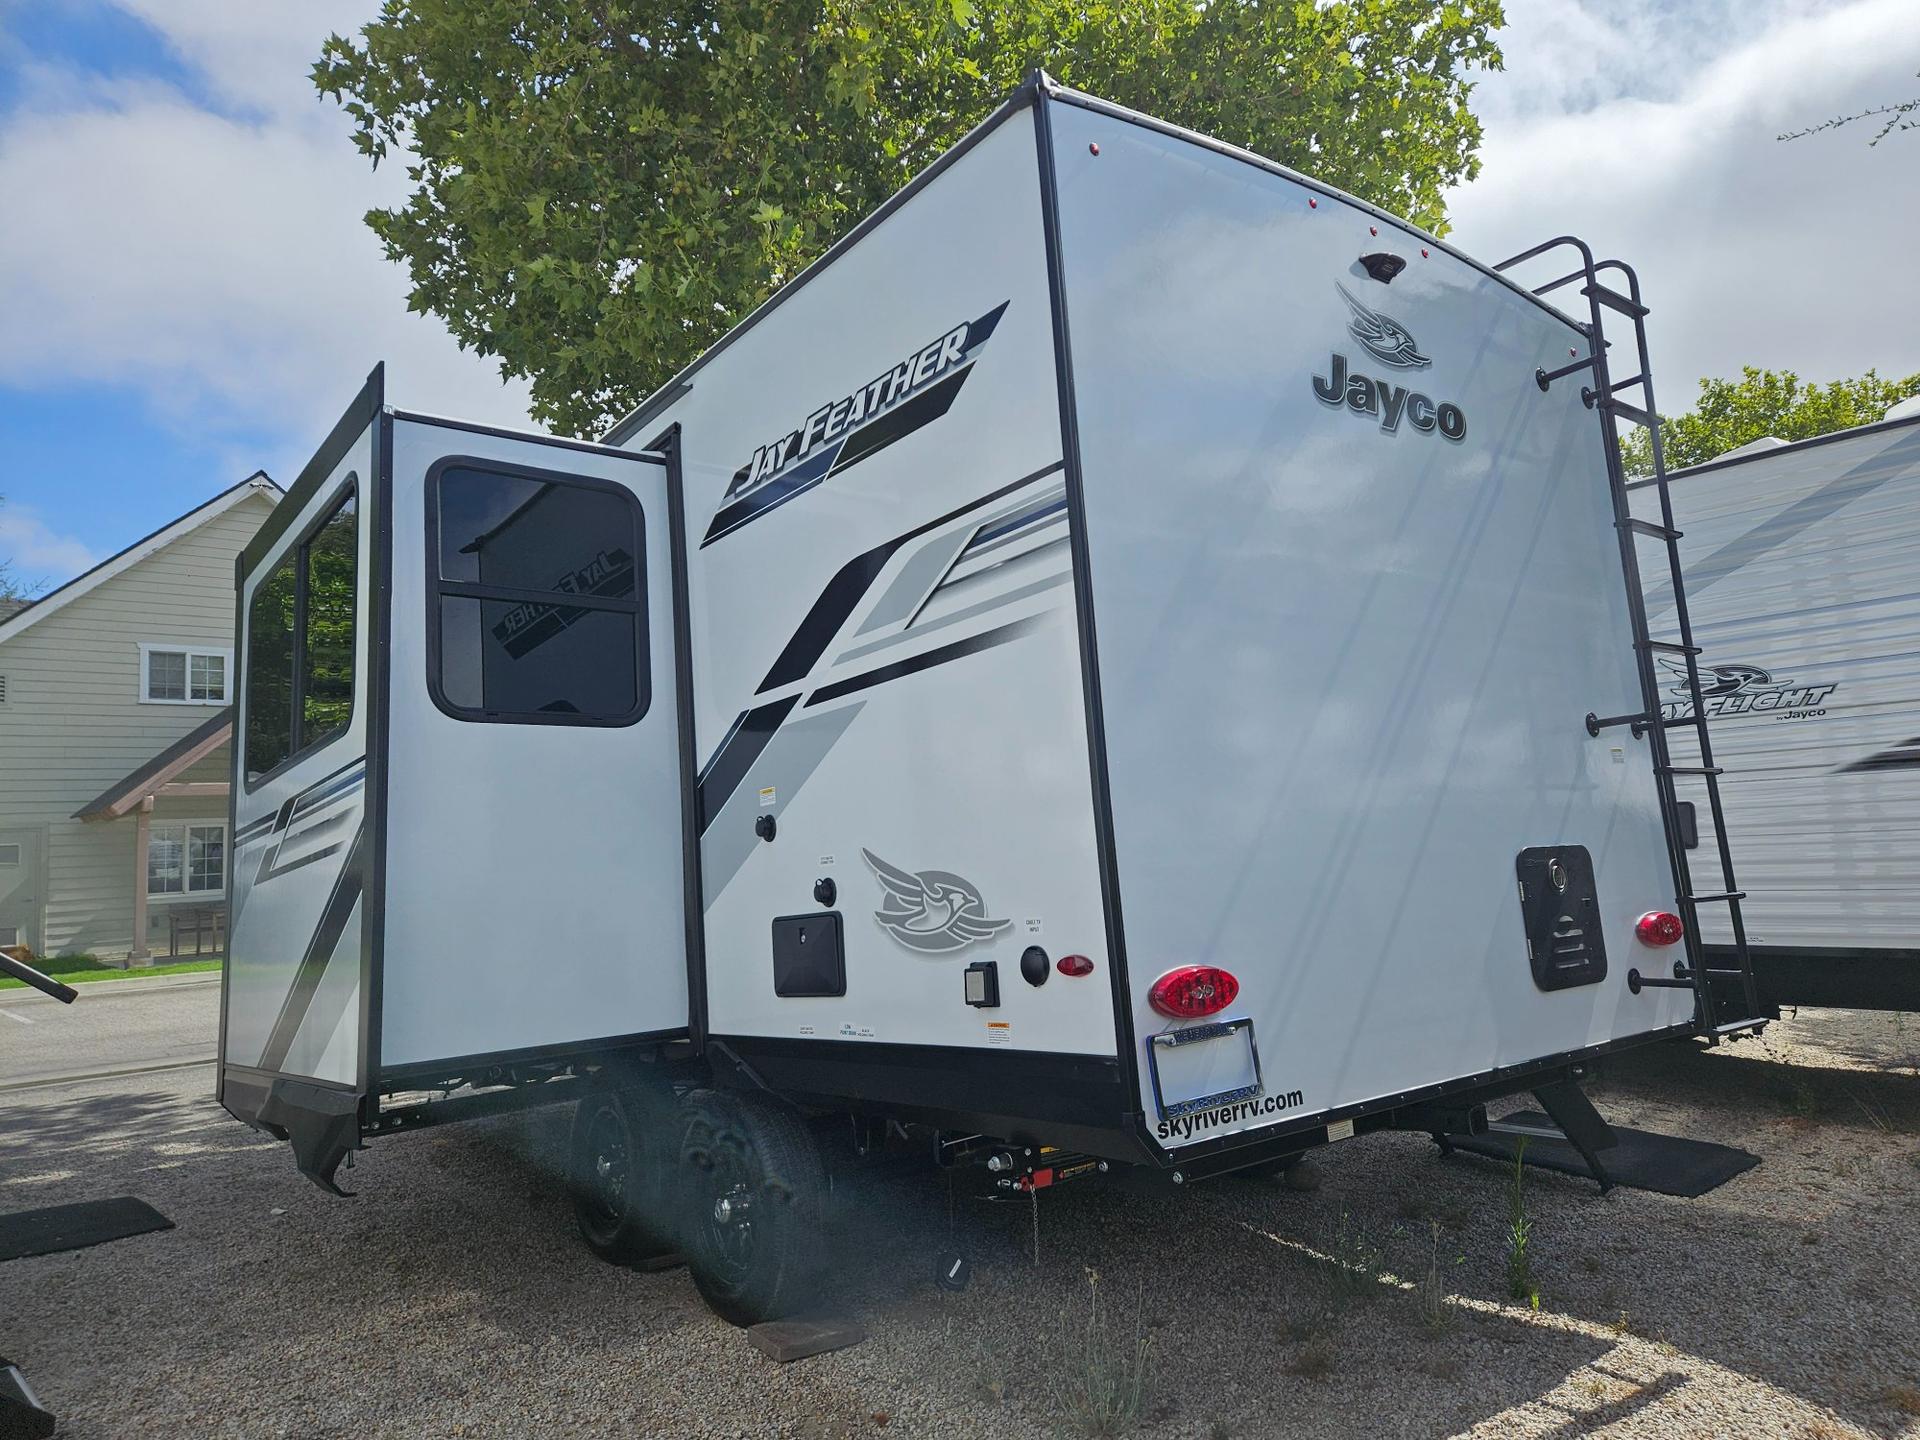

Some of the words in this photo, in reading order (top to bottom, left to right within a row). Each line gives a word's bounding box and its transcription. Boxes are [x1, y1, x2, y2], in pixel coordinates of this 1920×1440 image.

[735, 430, 799, 498] JAY
[798, 321, 971, 460] FEATHER
[1311, 352, 1467, 439] Jayco
[1703, 683, 1839, 717] FLIGHT
[1784, 708, 1826, 720] Jayco
[1157, 1089, 1304, 1140] skyriverrv.com
